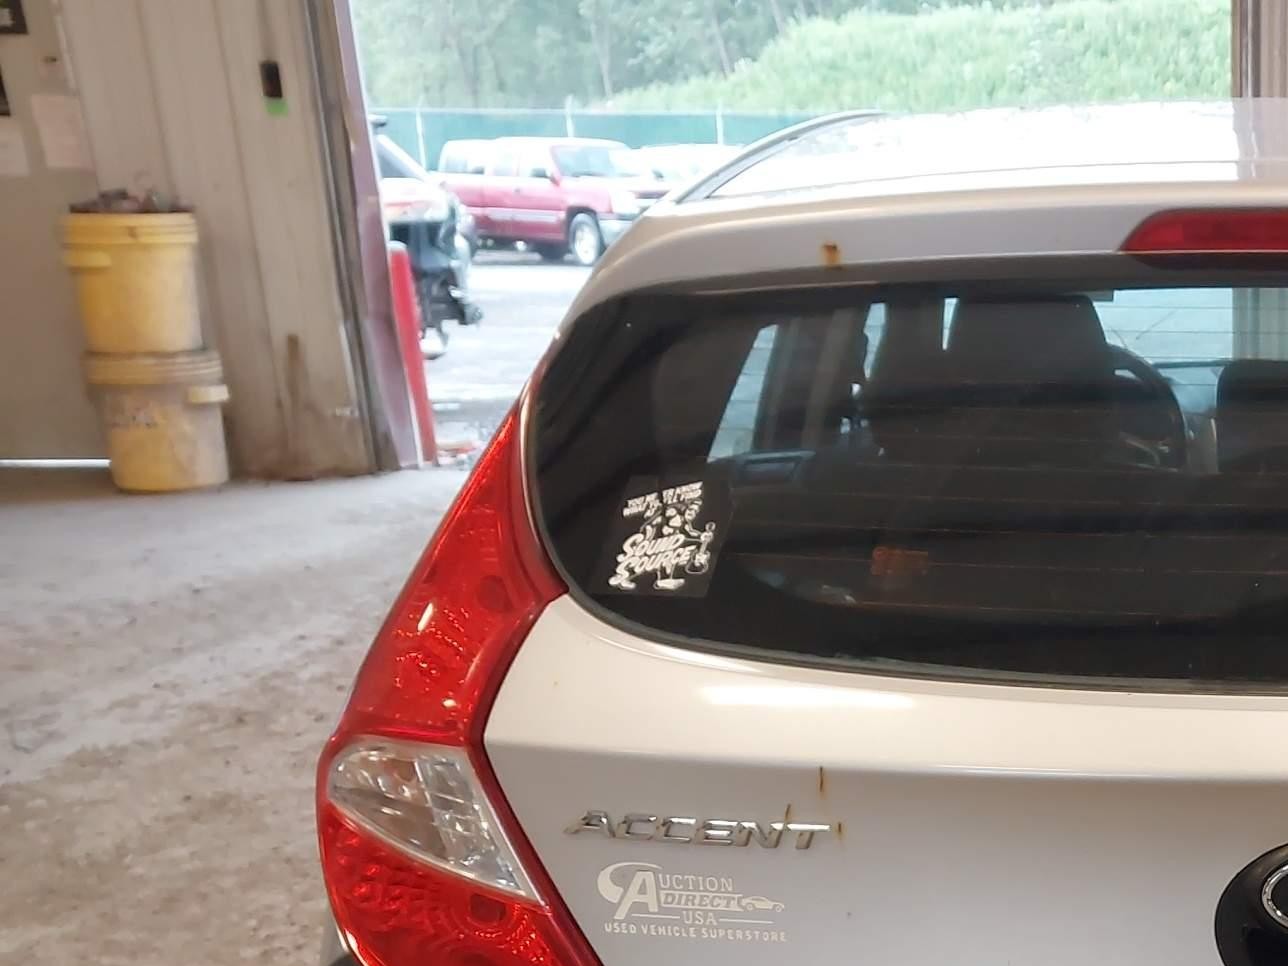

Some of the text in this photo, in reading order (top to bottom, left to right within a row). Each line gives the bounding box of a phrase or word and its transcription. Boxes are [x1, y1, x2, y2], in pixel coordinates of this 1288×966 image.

[617, 533, 685, 562] SOUND
[609, 545, 697, 583] SOURCE
[563, 810, 831, 850] ACCENT
[614, 869, 734, 921] AUCTION
[662, 892, 737, 909] DIRECT
[604, 923, 787, 942] USED VEHICLE SUPERSTORE
[682, 911, 718, 926] USA
